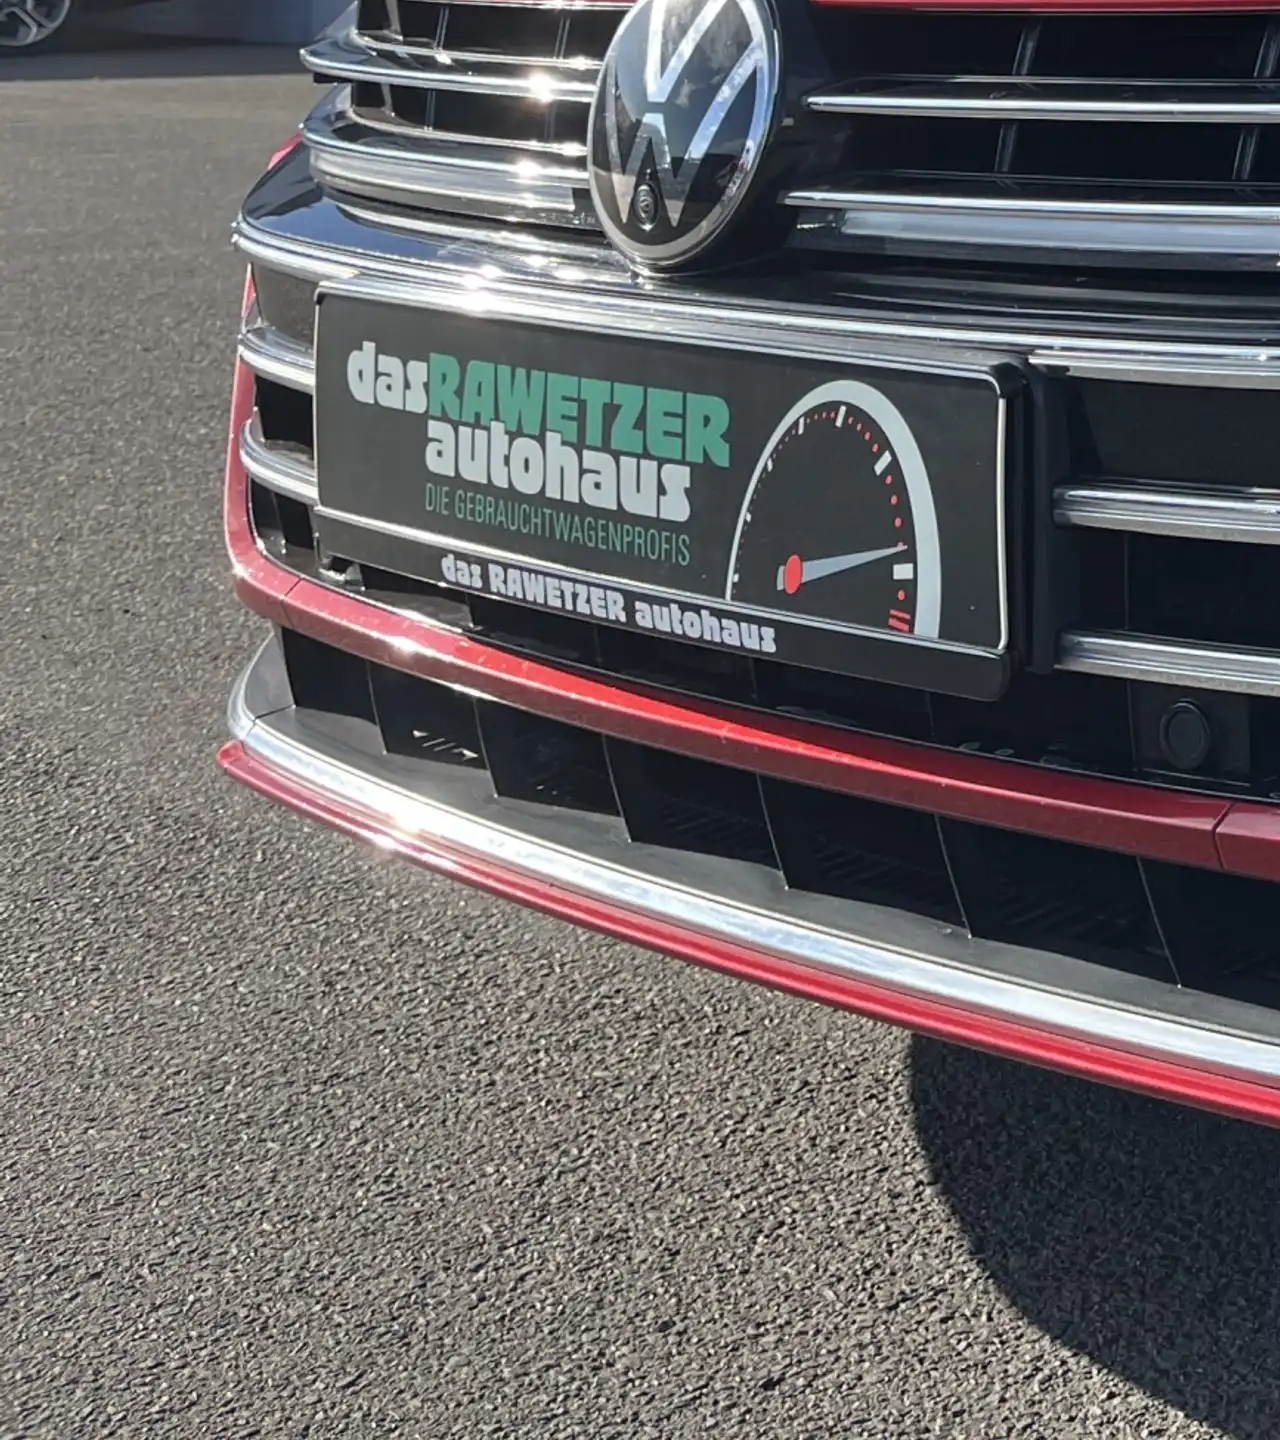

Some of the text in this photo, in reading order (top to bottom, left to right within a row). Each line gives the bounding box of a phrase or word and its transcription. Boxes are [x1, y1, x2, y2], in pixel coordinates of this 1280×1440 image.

[425, 419, 691, 522] autohaus
[425, 482, 691, 566] DIE GEBRAUCHTWAGENPROFIS
[441, 553, 777, 653] das RAWETZER autohaus
